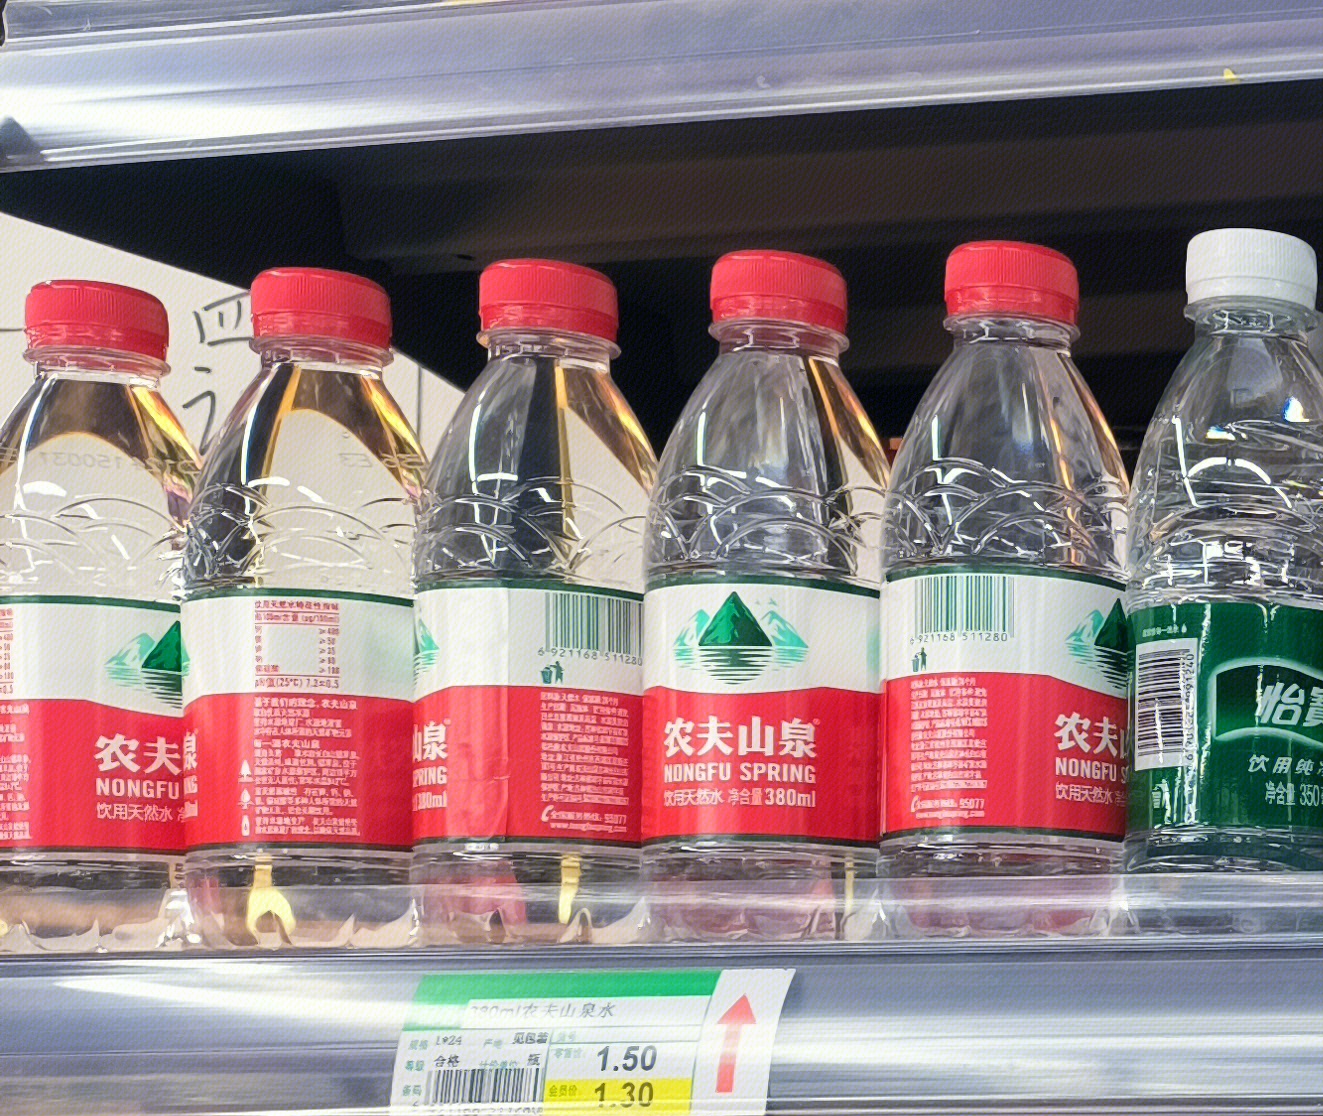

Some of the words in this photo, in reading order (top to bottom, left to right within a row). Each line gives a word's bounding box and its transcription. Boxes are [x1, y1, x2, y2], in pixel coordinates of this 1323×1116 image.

[664, 715, 817, 758] 农夫山泉
[664, 762, 732, 783] NONGFU
[739, 762, 816, 784] SPRING
[1055, 757, 1117, 782] NONGFU
[96, 777, 179, 800] NONGFU
[433, 1054, 461, 1068] 合格
[596, 1044, 658, 1073] 1.50
[594, 1081, 655, 1108] 1.30
